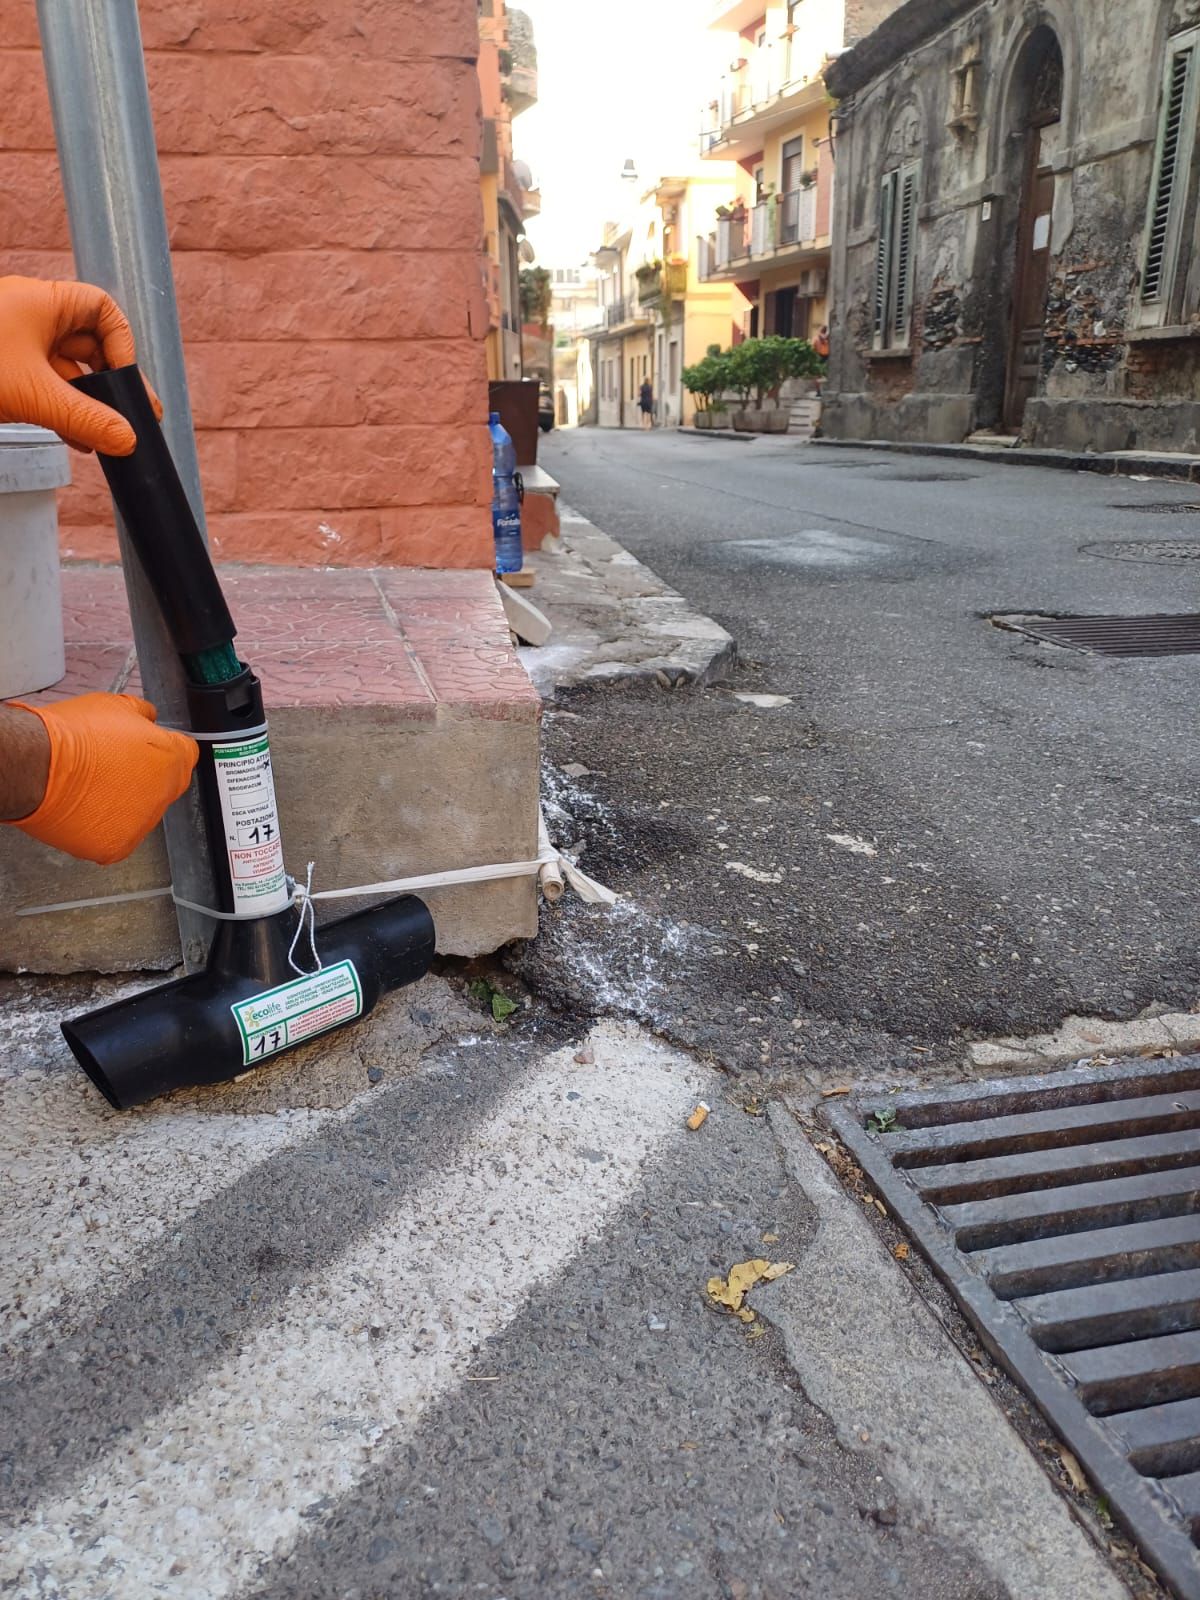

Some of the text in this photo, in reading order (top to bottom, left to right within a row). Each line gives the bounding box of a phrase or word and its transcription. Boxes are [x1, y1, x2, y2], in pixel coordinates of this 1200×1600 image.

[218, 758, 254, 768] PRINCIPIO
[236, 811, 275, 827] POSTAZIONE
[249, 824, 275, 844] 17
[234, 851, 252, 859] NON
[252, 1001, 281, 1020] ecolife
[254, 1031, 281, 1054] 17
